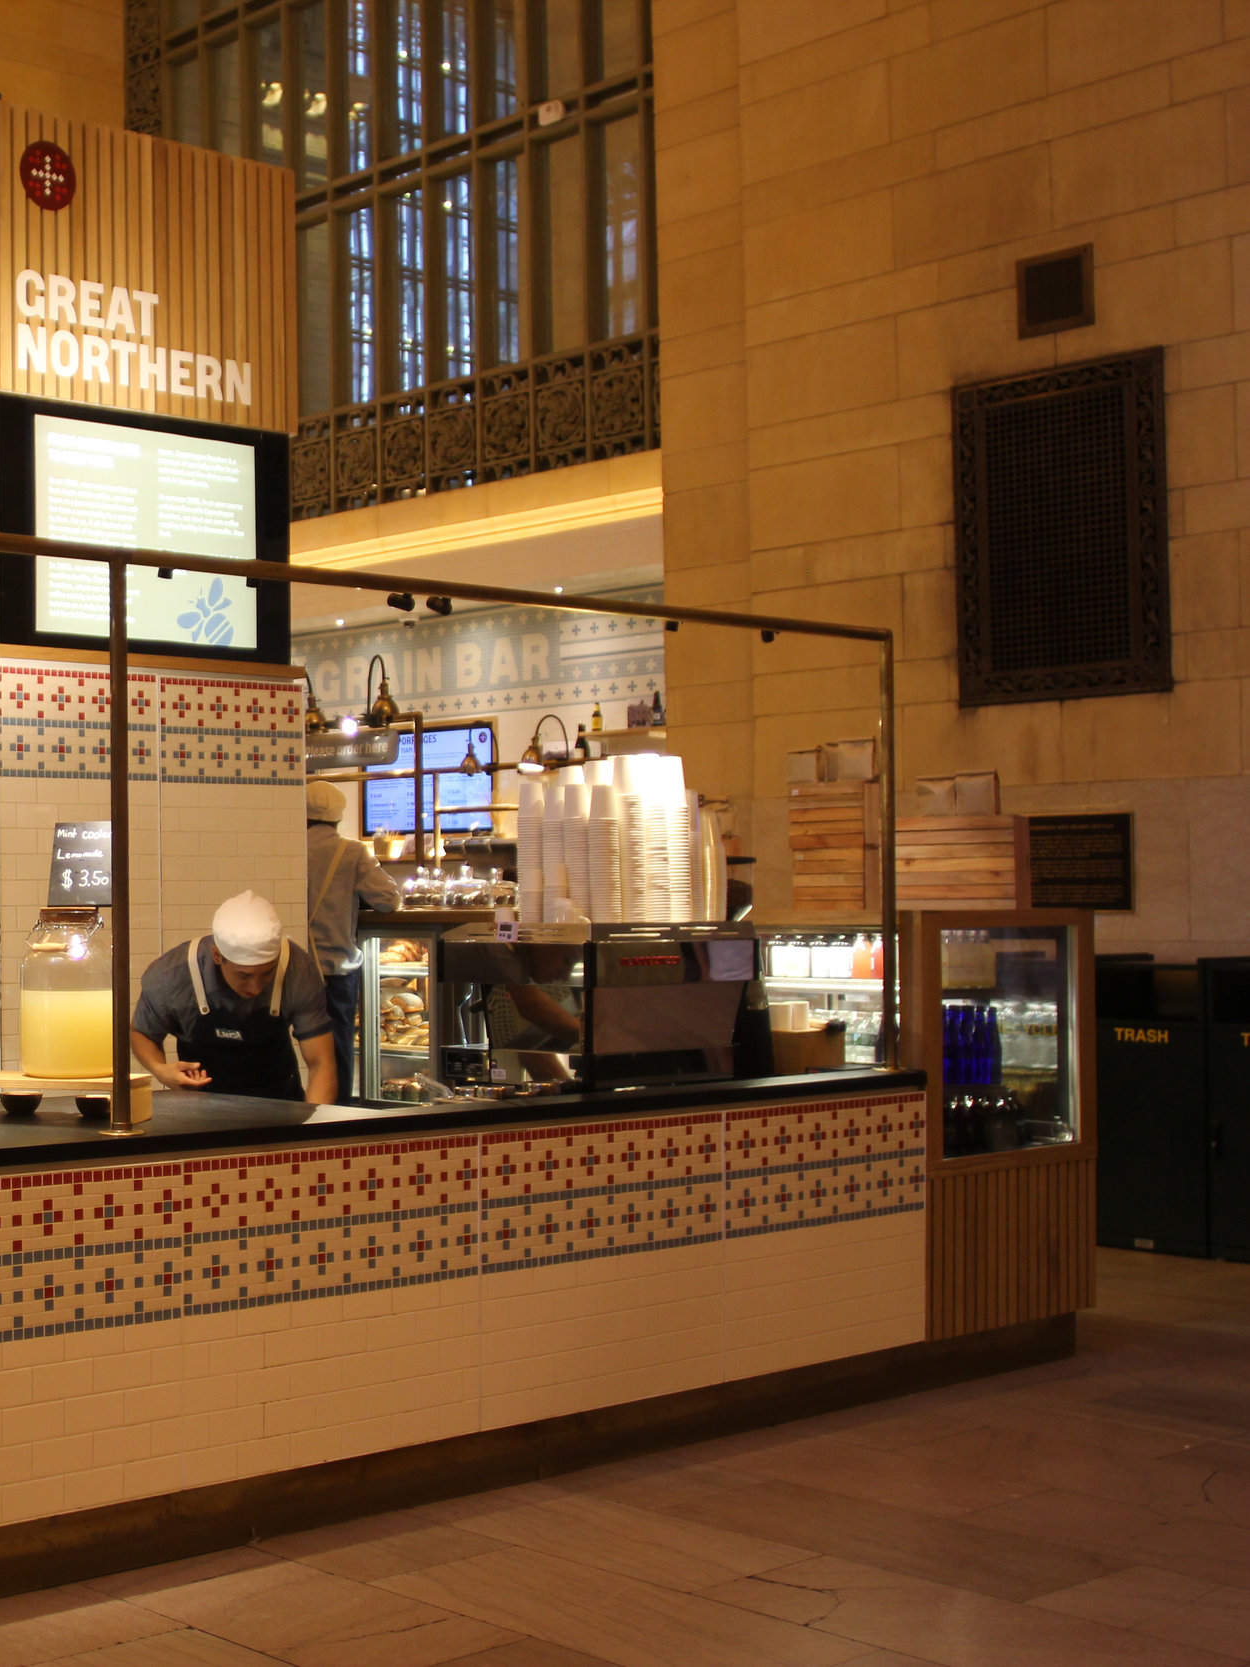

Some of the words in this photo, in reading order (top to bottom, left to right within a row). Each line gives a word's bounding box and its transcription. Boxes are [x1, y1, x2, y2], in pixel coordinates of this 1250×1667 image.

[16, 269, 159, 337] GREAT
[16, 324, 252, 406] NORTHERN
[316, 647, 442, 701] GRAIN
[456, 633, 550, 689] BAR
[337, 742, 363, 755] order
[365, 741, 389, 754] here
[56, 828, 77, 838] Mint
[61, 868, 73, 892] $
[78, 869, 110, 887] 3.50
[1114, 1027, 1169, 1044] TRASH
